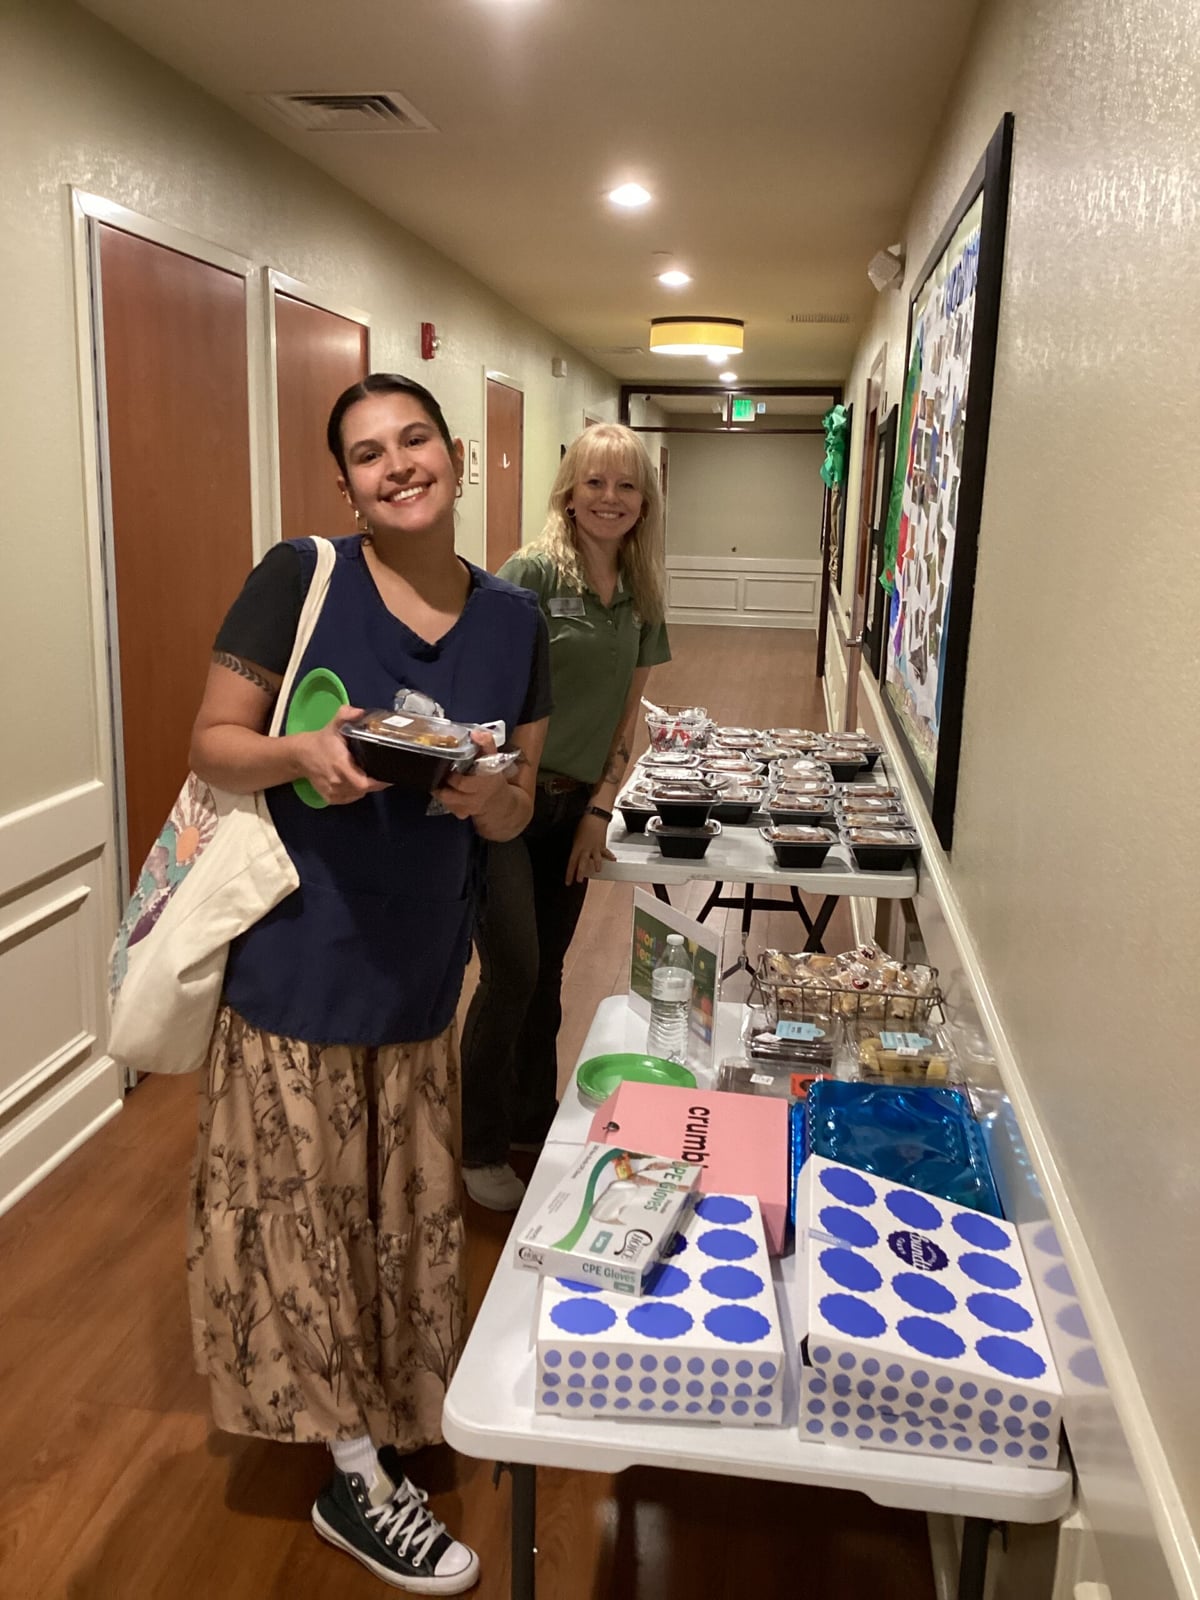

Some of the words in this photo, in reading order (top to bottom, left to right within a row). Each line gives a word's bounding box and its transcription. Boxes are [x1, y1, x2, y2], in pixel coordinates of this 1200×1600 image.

[681, 1106, 710, 1169] crumb
[644, 1182, 677, 1211] Gloves
[909, 1232, 933, 1271] bundt
[582, 1262, 602, 1276] CPE
[603, 1265, 636, 1283] Gloves
